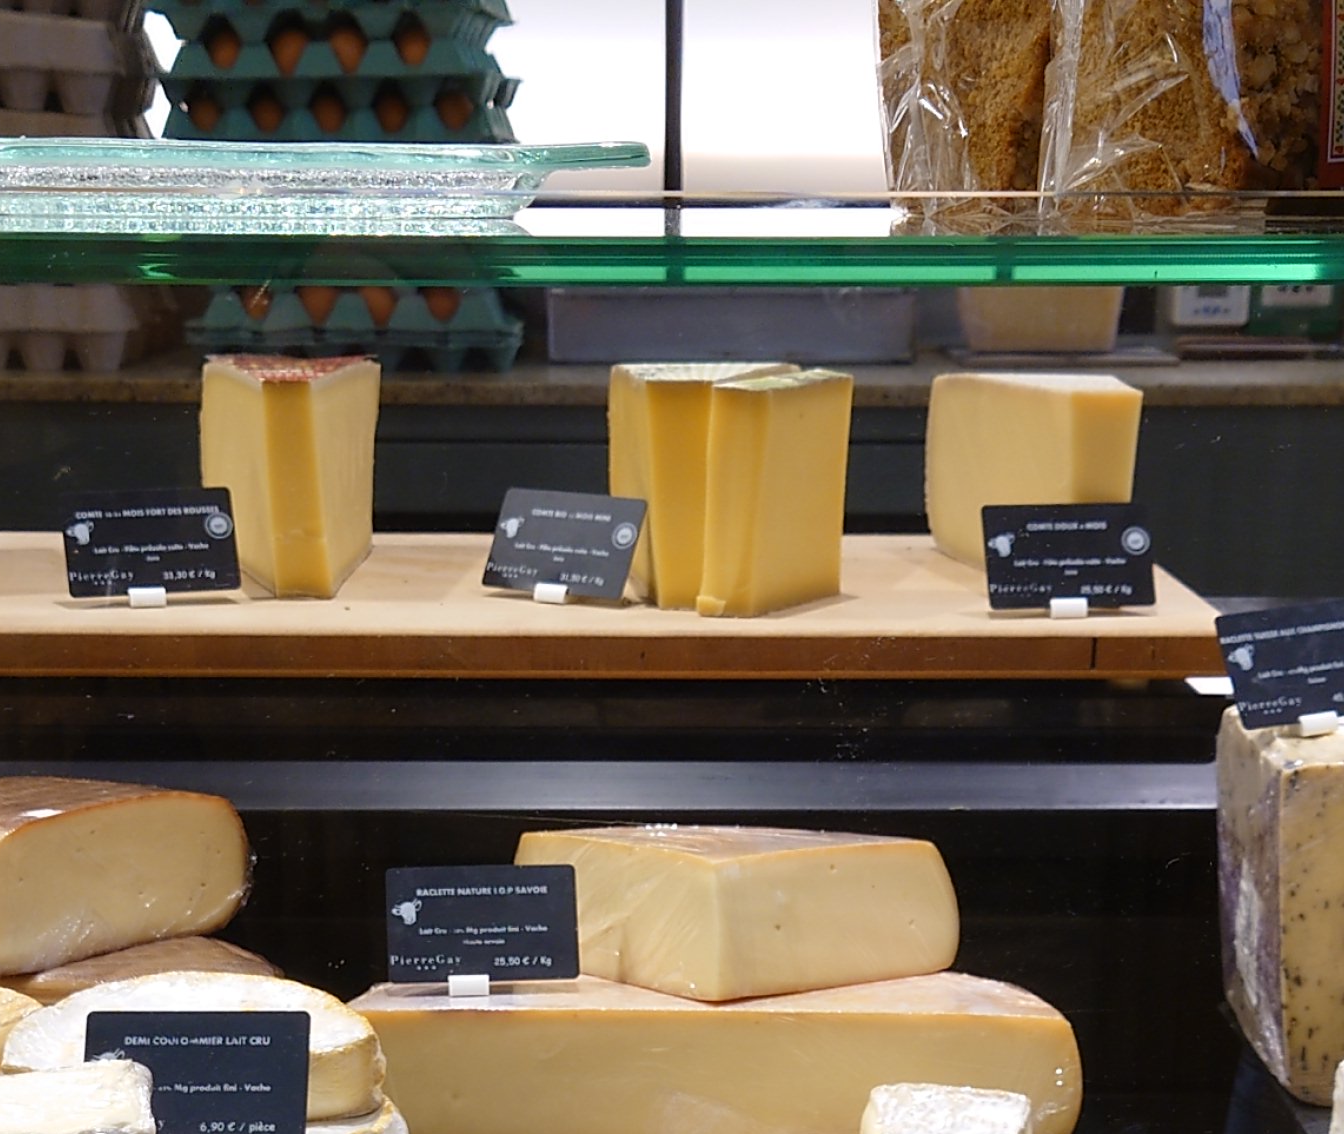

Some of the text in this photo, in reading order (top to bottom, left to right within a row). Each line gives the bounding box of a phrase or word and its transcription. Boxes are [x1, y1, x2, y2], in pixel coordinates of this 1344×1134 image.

[416, 888, 455, 896] RACLETTE
[457, 887, 491, 895] NATURE
[125, 1037, 270, 1045] DEMI LAIT CRU
[200, 1121, 275, 1133] 6,90 pièce
